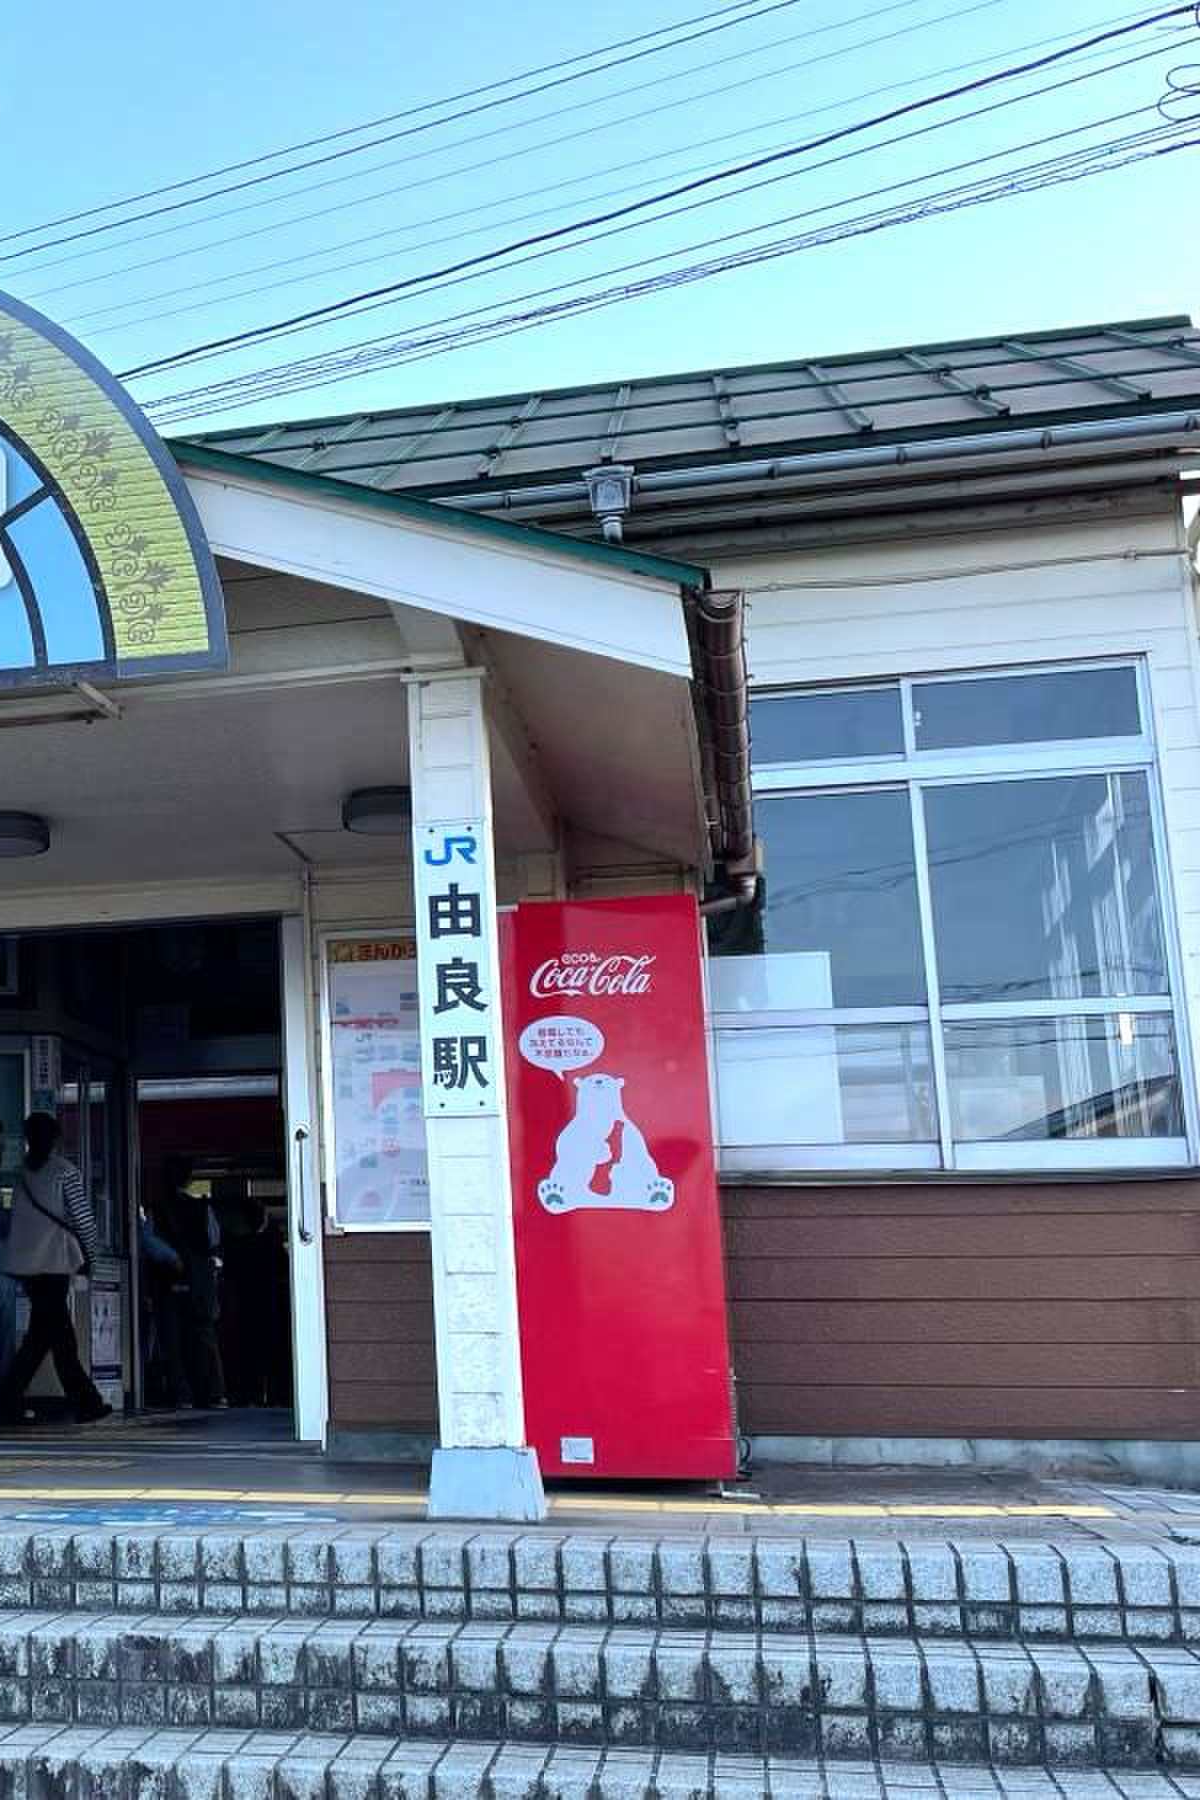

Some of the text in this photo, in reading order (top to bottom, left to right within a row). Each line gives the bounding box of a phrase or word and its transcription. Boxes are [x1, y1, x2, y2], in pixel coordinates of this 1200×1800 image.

[424, 835, 490, 1091] JR 由良駅
[528, 954, 657, 999] Coca-Cola
